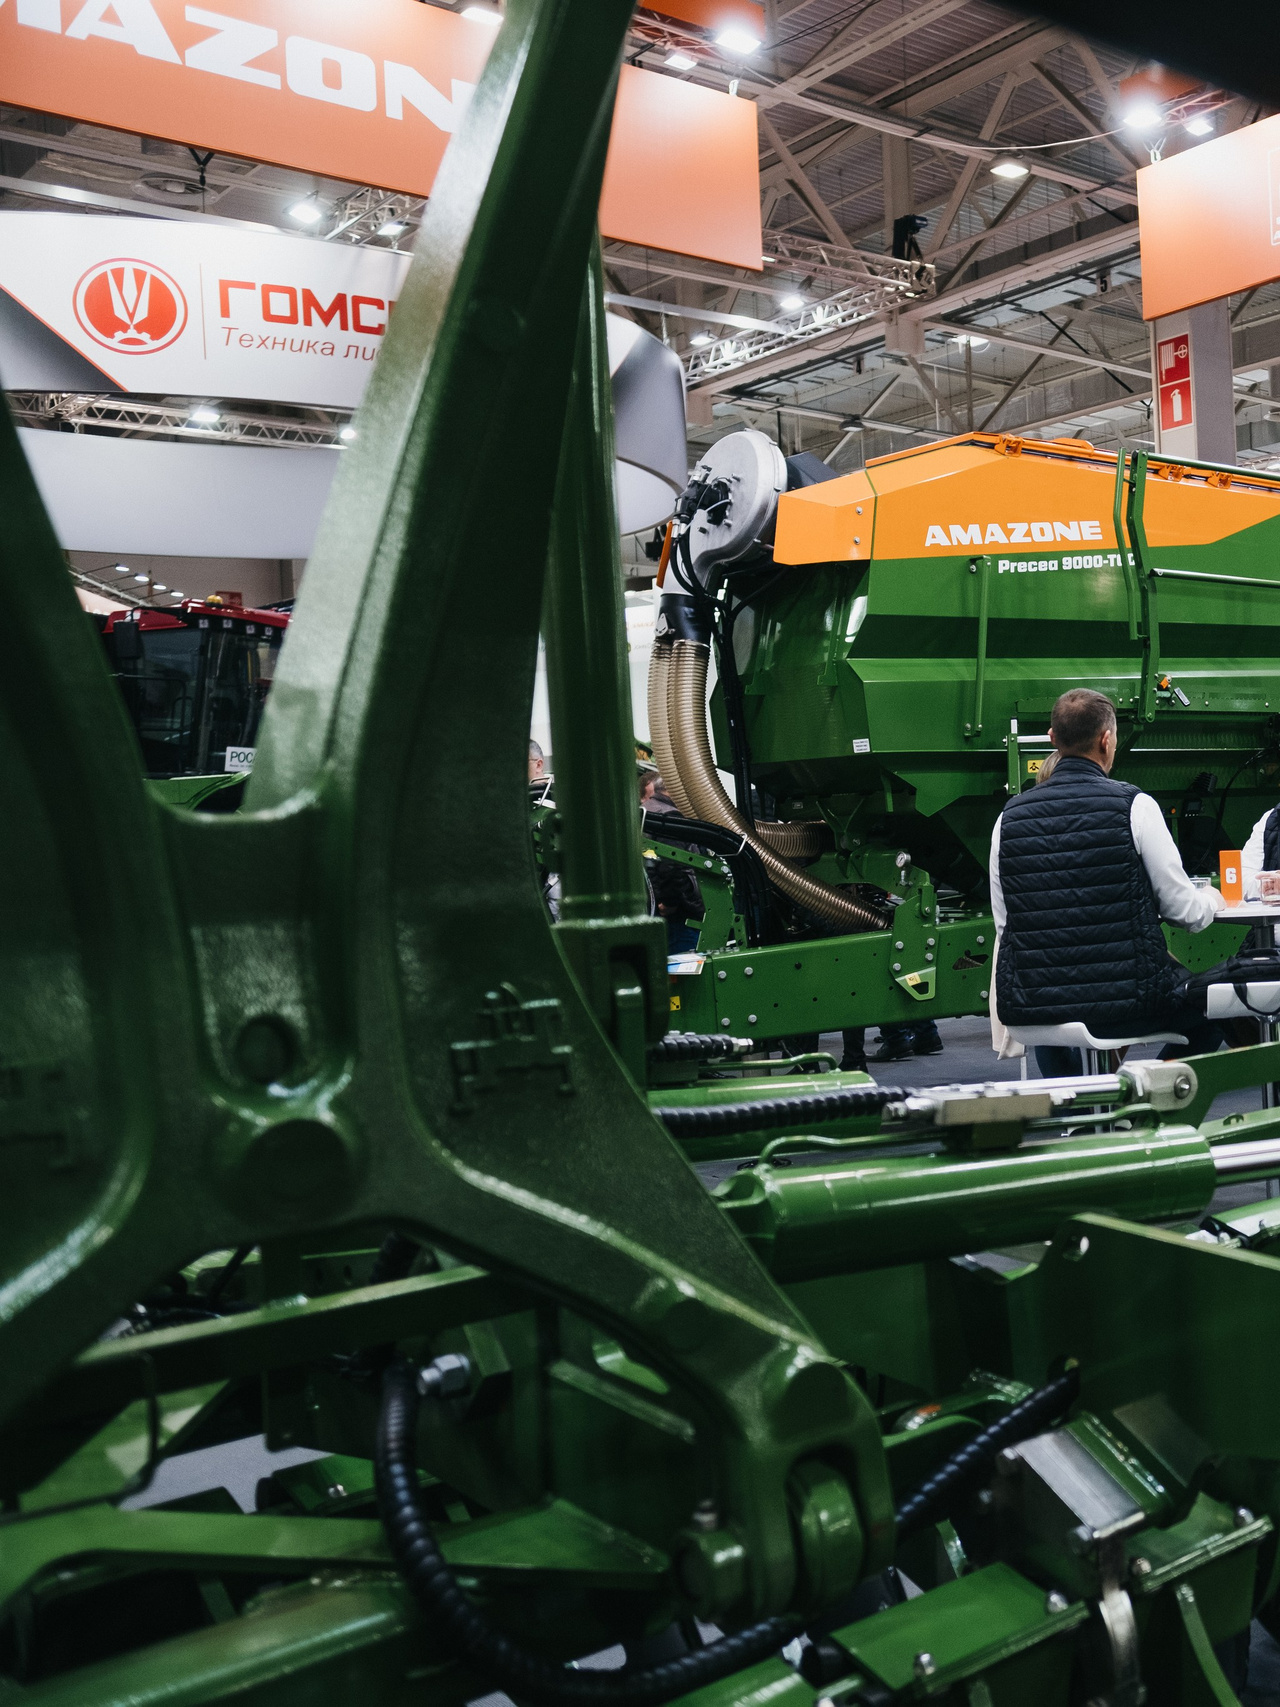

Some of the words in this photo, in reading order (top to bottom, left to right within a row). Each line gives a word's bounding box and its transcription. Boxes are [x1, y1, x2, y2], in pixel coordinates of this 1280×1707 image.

[0, 0, 478, 134] AZON
[218, 279, 396, 336] ГОМС
[221, 327, 335, 356] Техника
[925, 520, 1103, 546] AMAZONE
[998, 559, 1059, 574] Precea
[1225, 867, 1237, 884] 6
